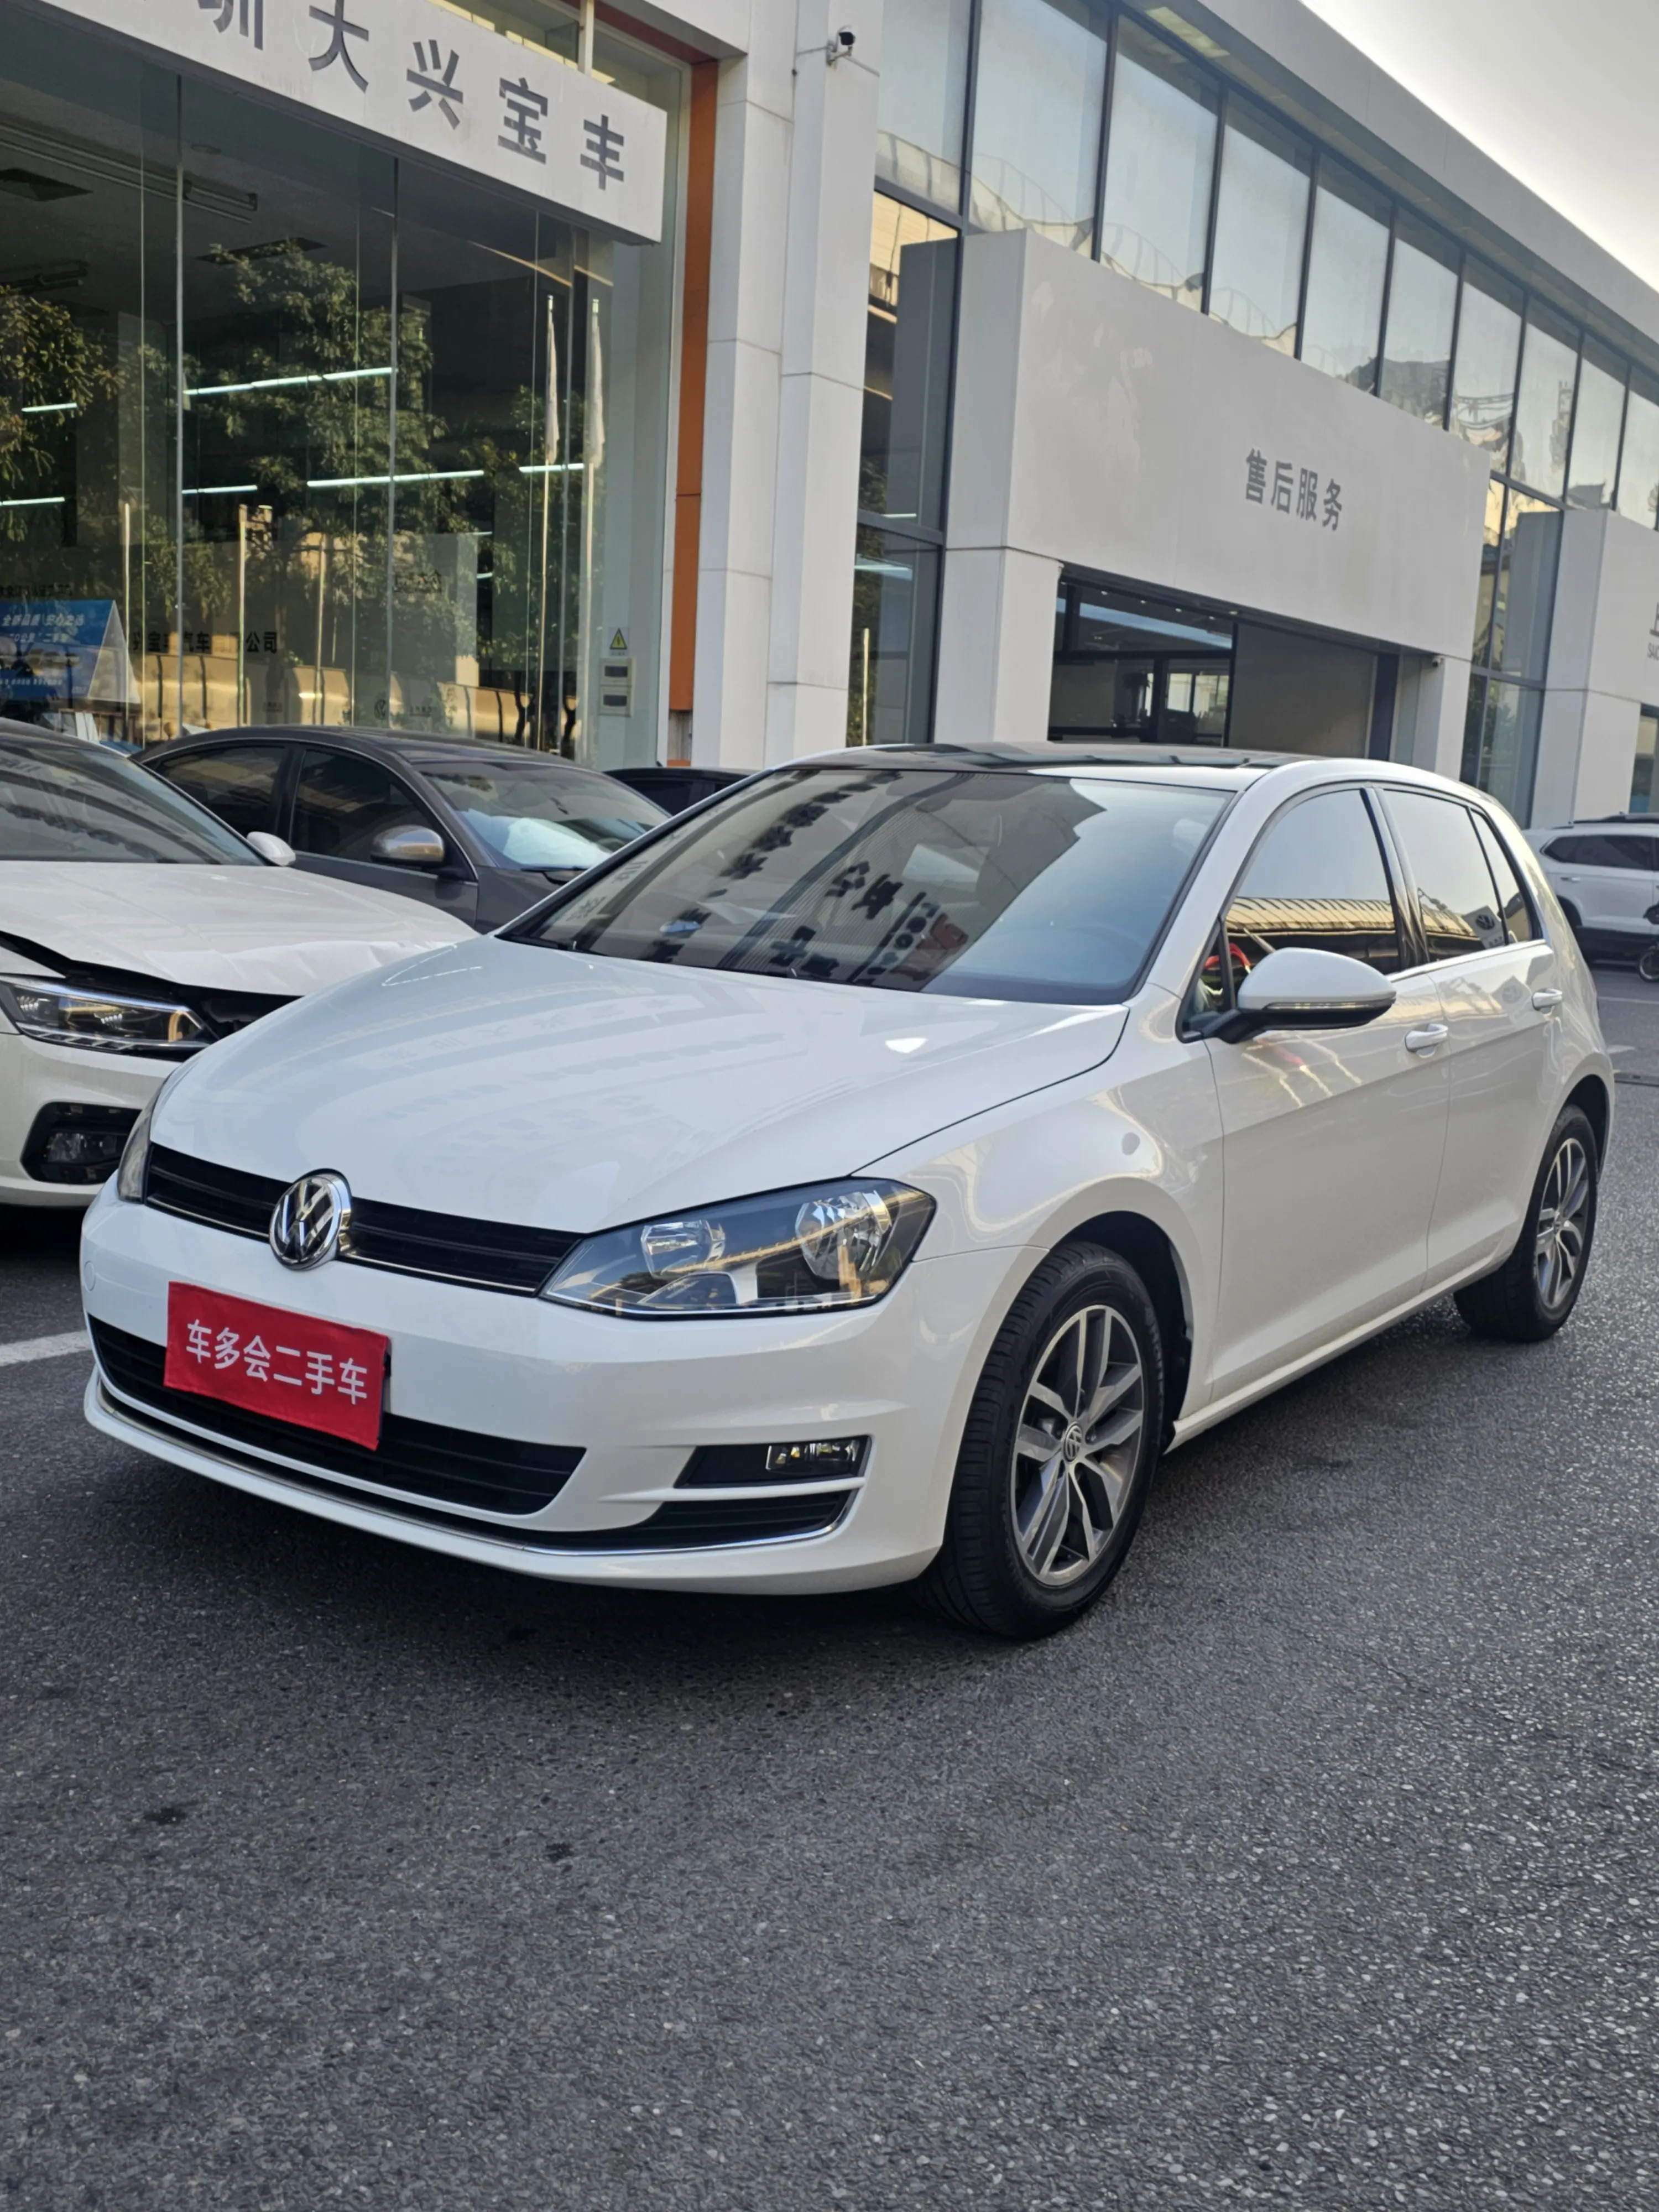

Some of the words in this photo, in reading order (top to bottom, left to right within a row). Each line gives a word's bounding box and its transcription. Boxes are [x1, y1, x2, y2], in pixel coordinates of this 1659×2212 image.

[1246, 447, 1342, 531] 售后服务
[186, 1319, 367, 1405] 车多会二手车
